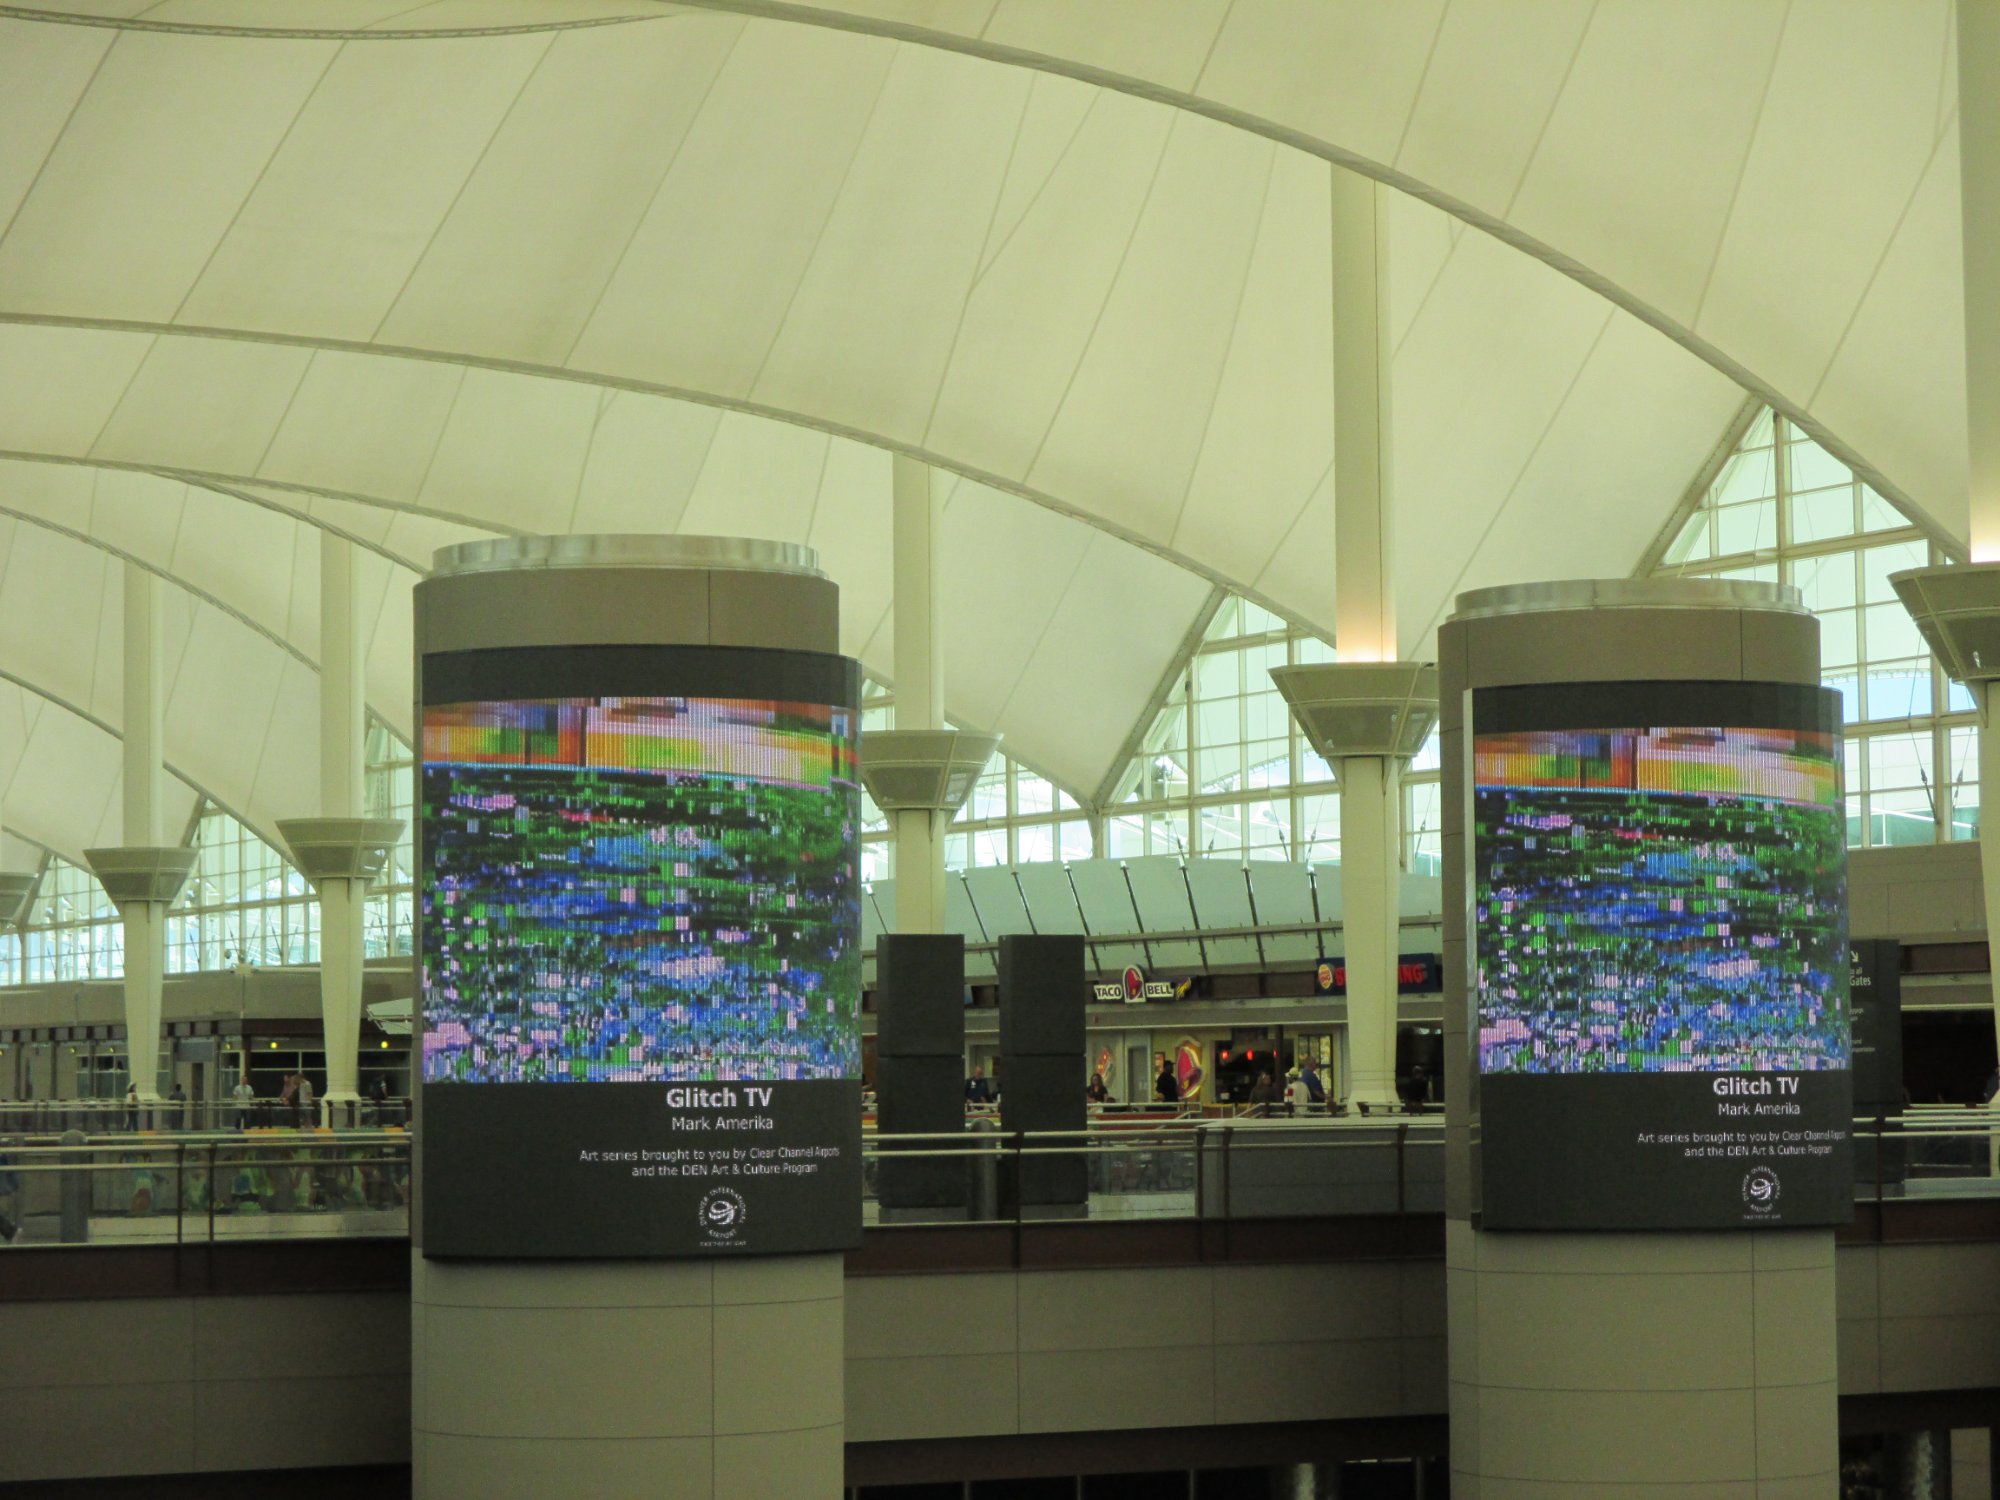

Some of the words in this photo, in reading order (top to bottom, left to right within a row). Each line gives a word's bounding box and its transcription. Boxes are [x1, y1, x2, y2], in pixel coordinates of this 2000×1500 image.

[1850, 976, 1872, 986] Gates
[1096, 987, 1121, 997] TACO
[1147, 985, 1173, 995] BELL
[1713, 1077, 1771, 1095] Glitch
[1777, 1077, 1799, 1094] TV
[666, 1087, 737, 1108] Glitch
[743, 1087, 773, 1107] TV
[1718, 1103, 1750, 1116] Mark
[1754, 1102, 1800, 1115] Amerika
[671, 1116, 711, 1131] Mark
[715, 1115, 774, 1130] Amerika
[1638, 1133, 1655, 1143] Art
[1658, 1133, 1690, 1143] series
[1693, 1132, 1734, 1144] brought
[1737, 1131, 1747, 1141] to
[1750, 1133, 1767, 1143] you
[1769, 1131, 1780, 1143] by
[579, 1150, 599, 1161] Art
[602, 1150, 638, 1161] series
[642, 1149, 690, 1162] brought
[694, 1149, 706, 1160] to
[709, 1150, 730, 1161] you
[733, 1148, 746, 1161] by
[749, 1147, 776, 1159] Clear
[778, 1146, 814, 1158] Channel
[1684, 1147, 1705, 1157] and
[1707, 1147, 1725, 1156] the
[1727, 1146, 1750, 1156] DEN
[1752, 1146, 1767, 1156] Art
[1769, 1146, 1775, 1155] &
[1777, 1145, 1806, 1155] Culture
[631, 1165, 655, 1177] and
[659, 1165, 678, 1176] the
[682, 1164, 708, 1176] DEN
[711, 1164, 729, 1175] Art
[732, 1163, 740, 1175] &
[743, 1163, 780, 1175] Culture
[783, 1162, 818, 1175] Program
